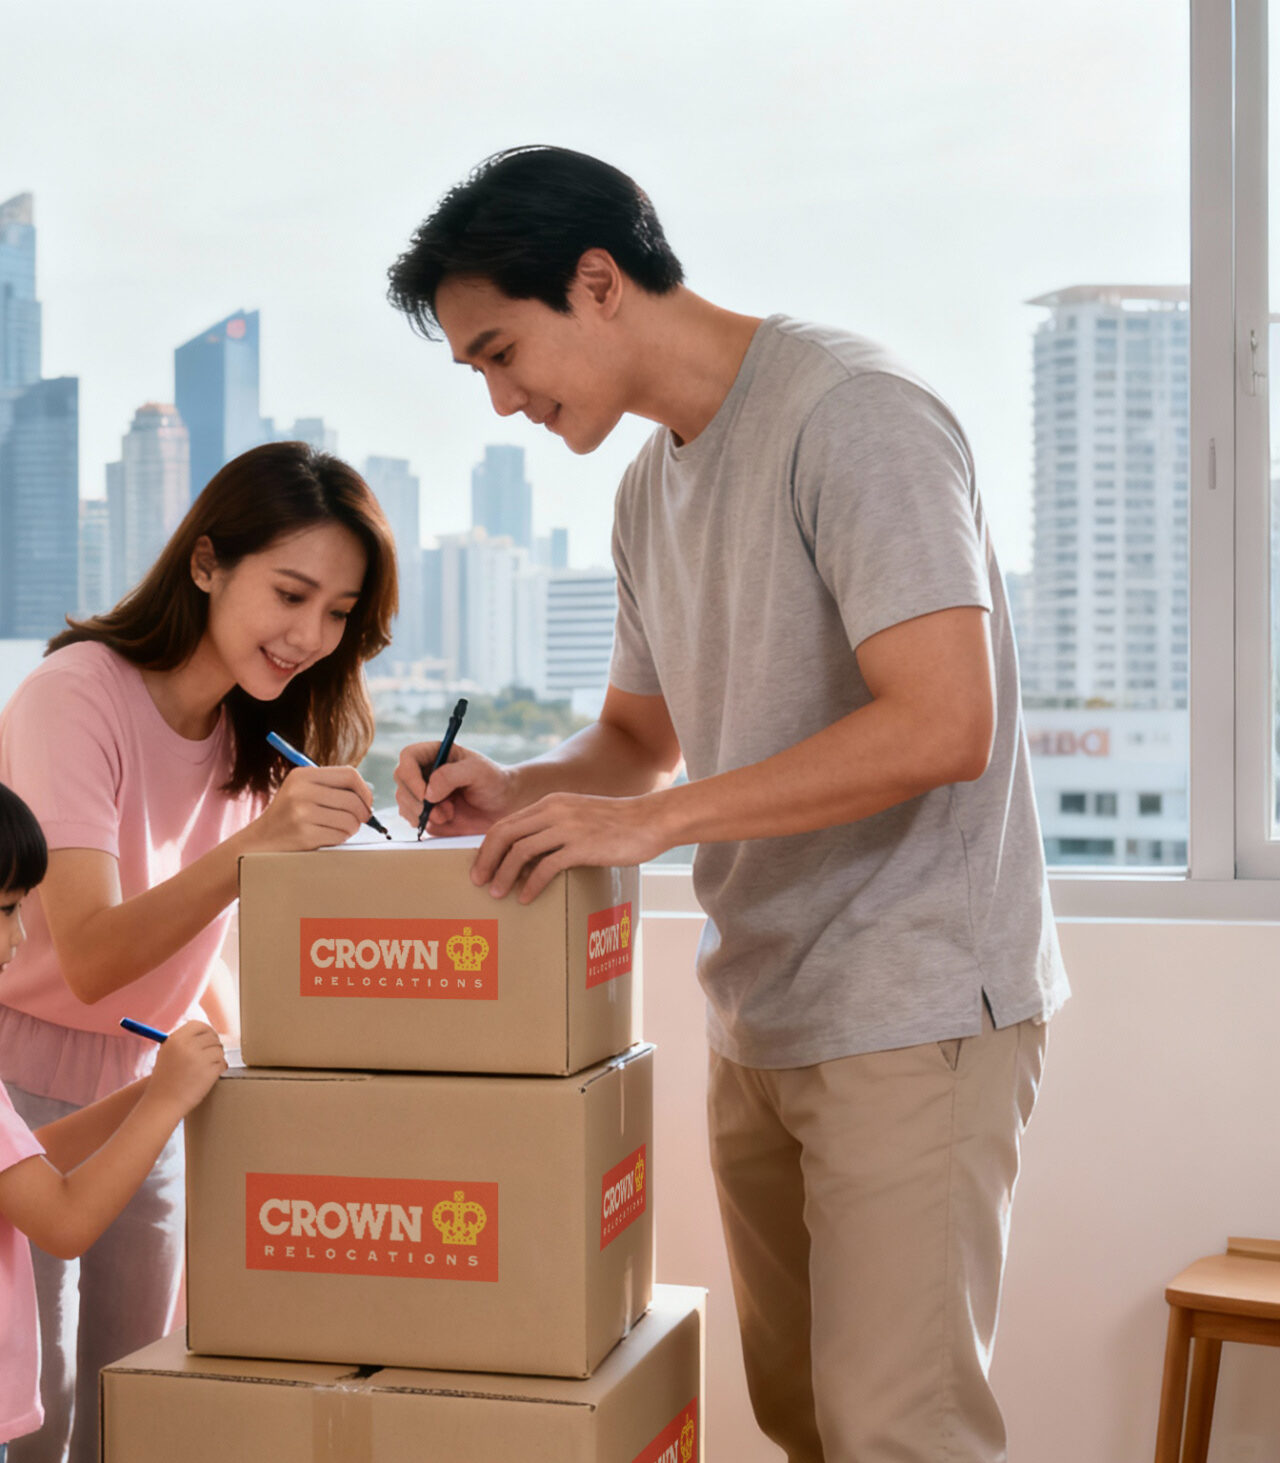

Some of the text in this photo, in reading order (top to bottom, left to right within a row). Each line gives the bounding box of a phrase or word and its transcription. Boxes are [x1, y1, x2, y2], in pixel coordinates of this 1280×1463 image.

[310, 938, 439, 970] CROWN
[588, 923, 620, 960] CROWN
[314, 976, 483, 989] RELOCATIONS
[603, 1170, 634, 1219] CROWN
[259, 1198, 423, 1242] CROWN
[264, 1245, 479, 1267] RELOCATIONS
